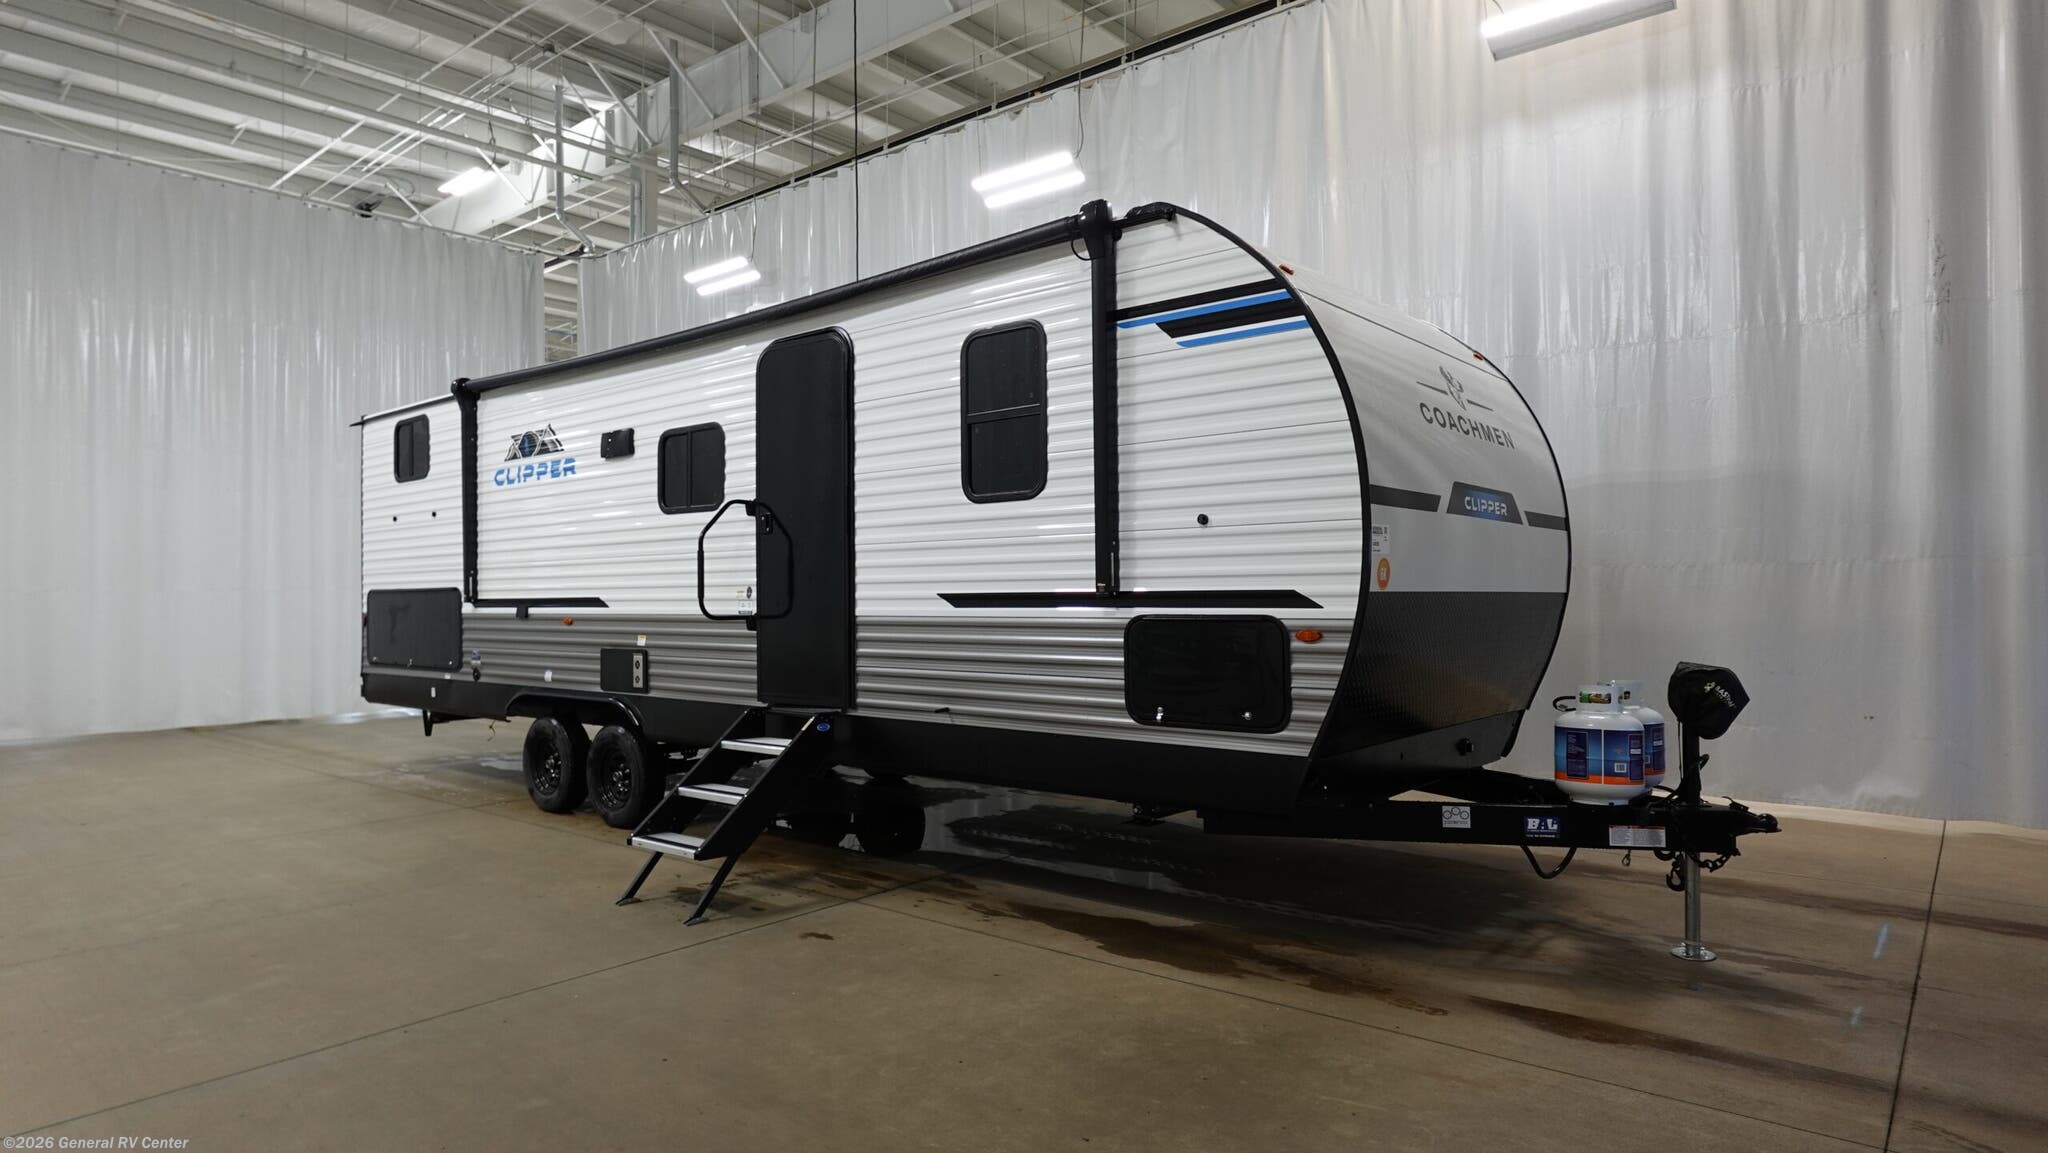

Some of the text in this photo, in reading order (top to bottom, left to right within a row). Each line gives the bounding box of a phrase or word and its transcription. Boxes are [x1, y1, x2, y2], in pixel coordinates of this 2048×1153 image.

[1419, 402, 1515, 449] COACHMEN
[494, 457, 577, 487] CLIPPER
[1464, 496, 1508, 517] CLIPPER
